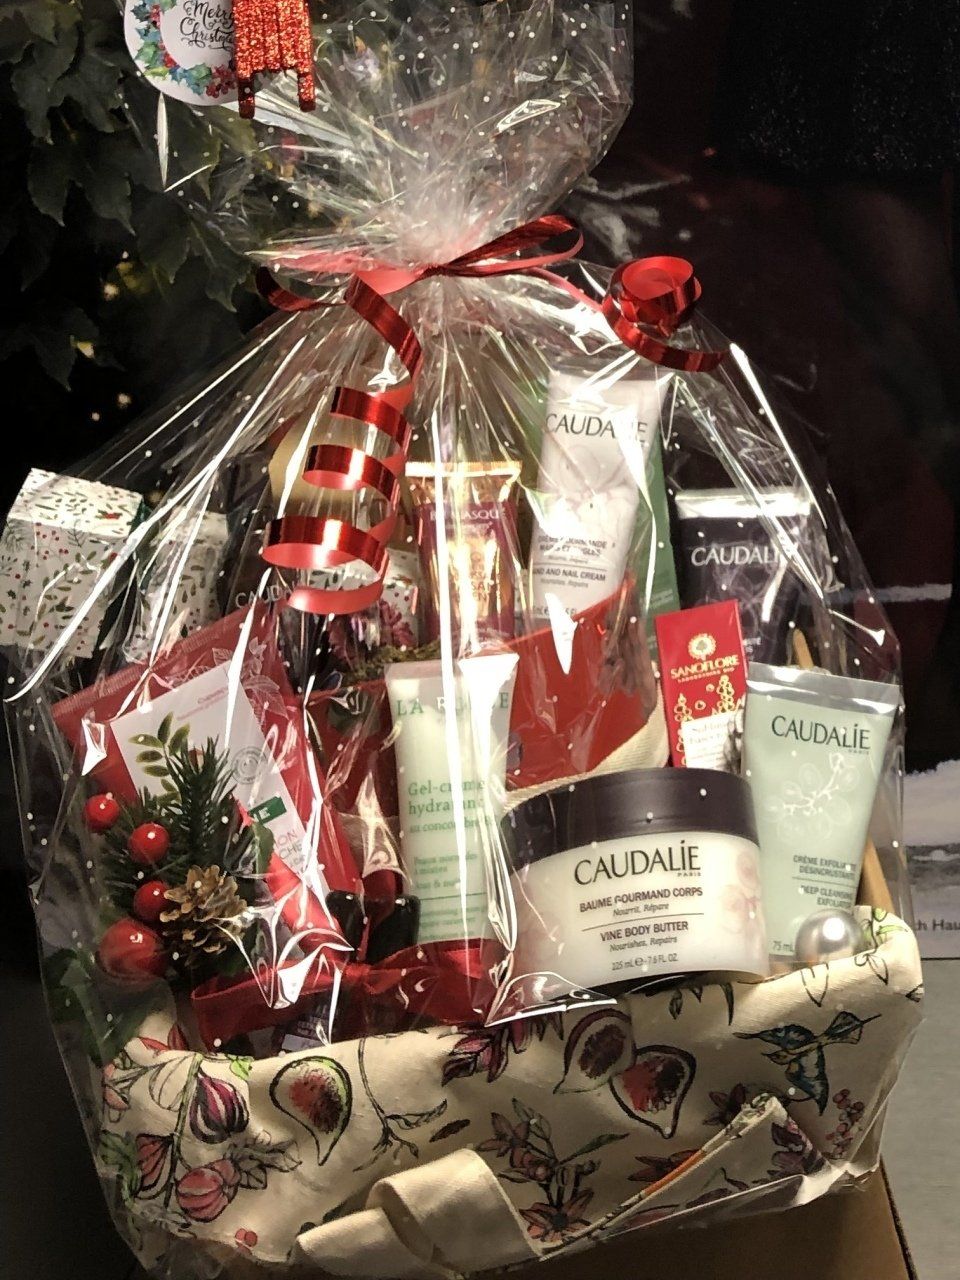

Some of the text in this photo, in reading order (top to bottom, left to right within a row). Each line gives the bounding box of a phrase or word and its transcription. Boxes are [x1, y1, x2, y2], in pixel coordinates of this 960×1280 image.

[580, 571, 606, 582] CREAM
[396, 698, 424, 717] LA
[579, 886, 704, 913] BAUME GOURMAND CORPS
[600, 920, 690, 942] VINE BODY BUTTER
